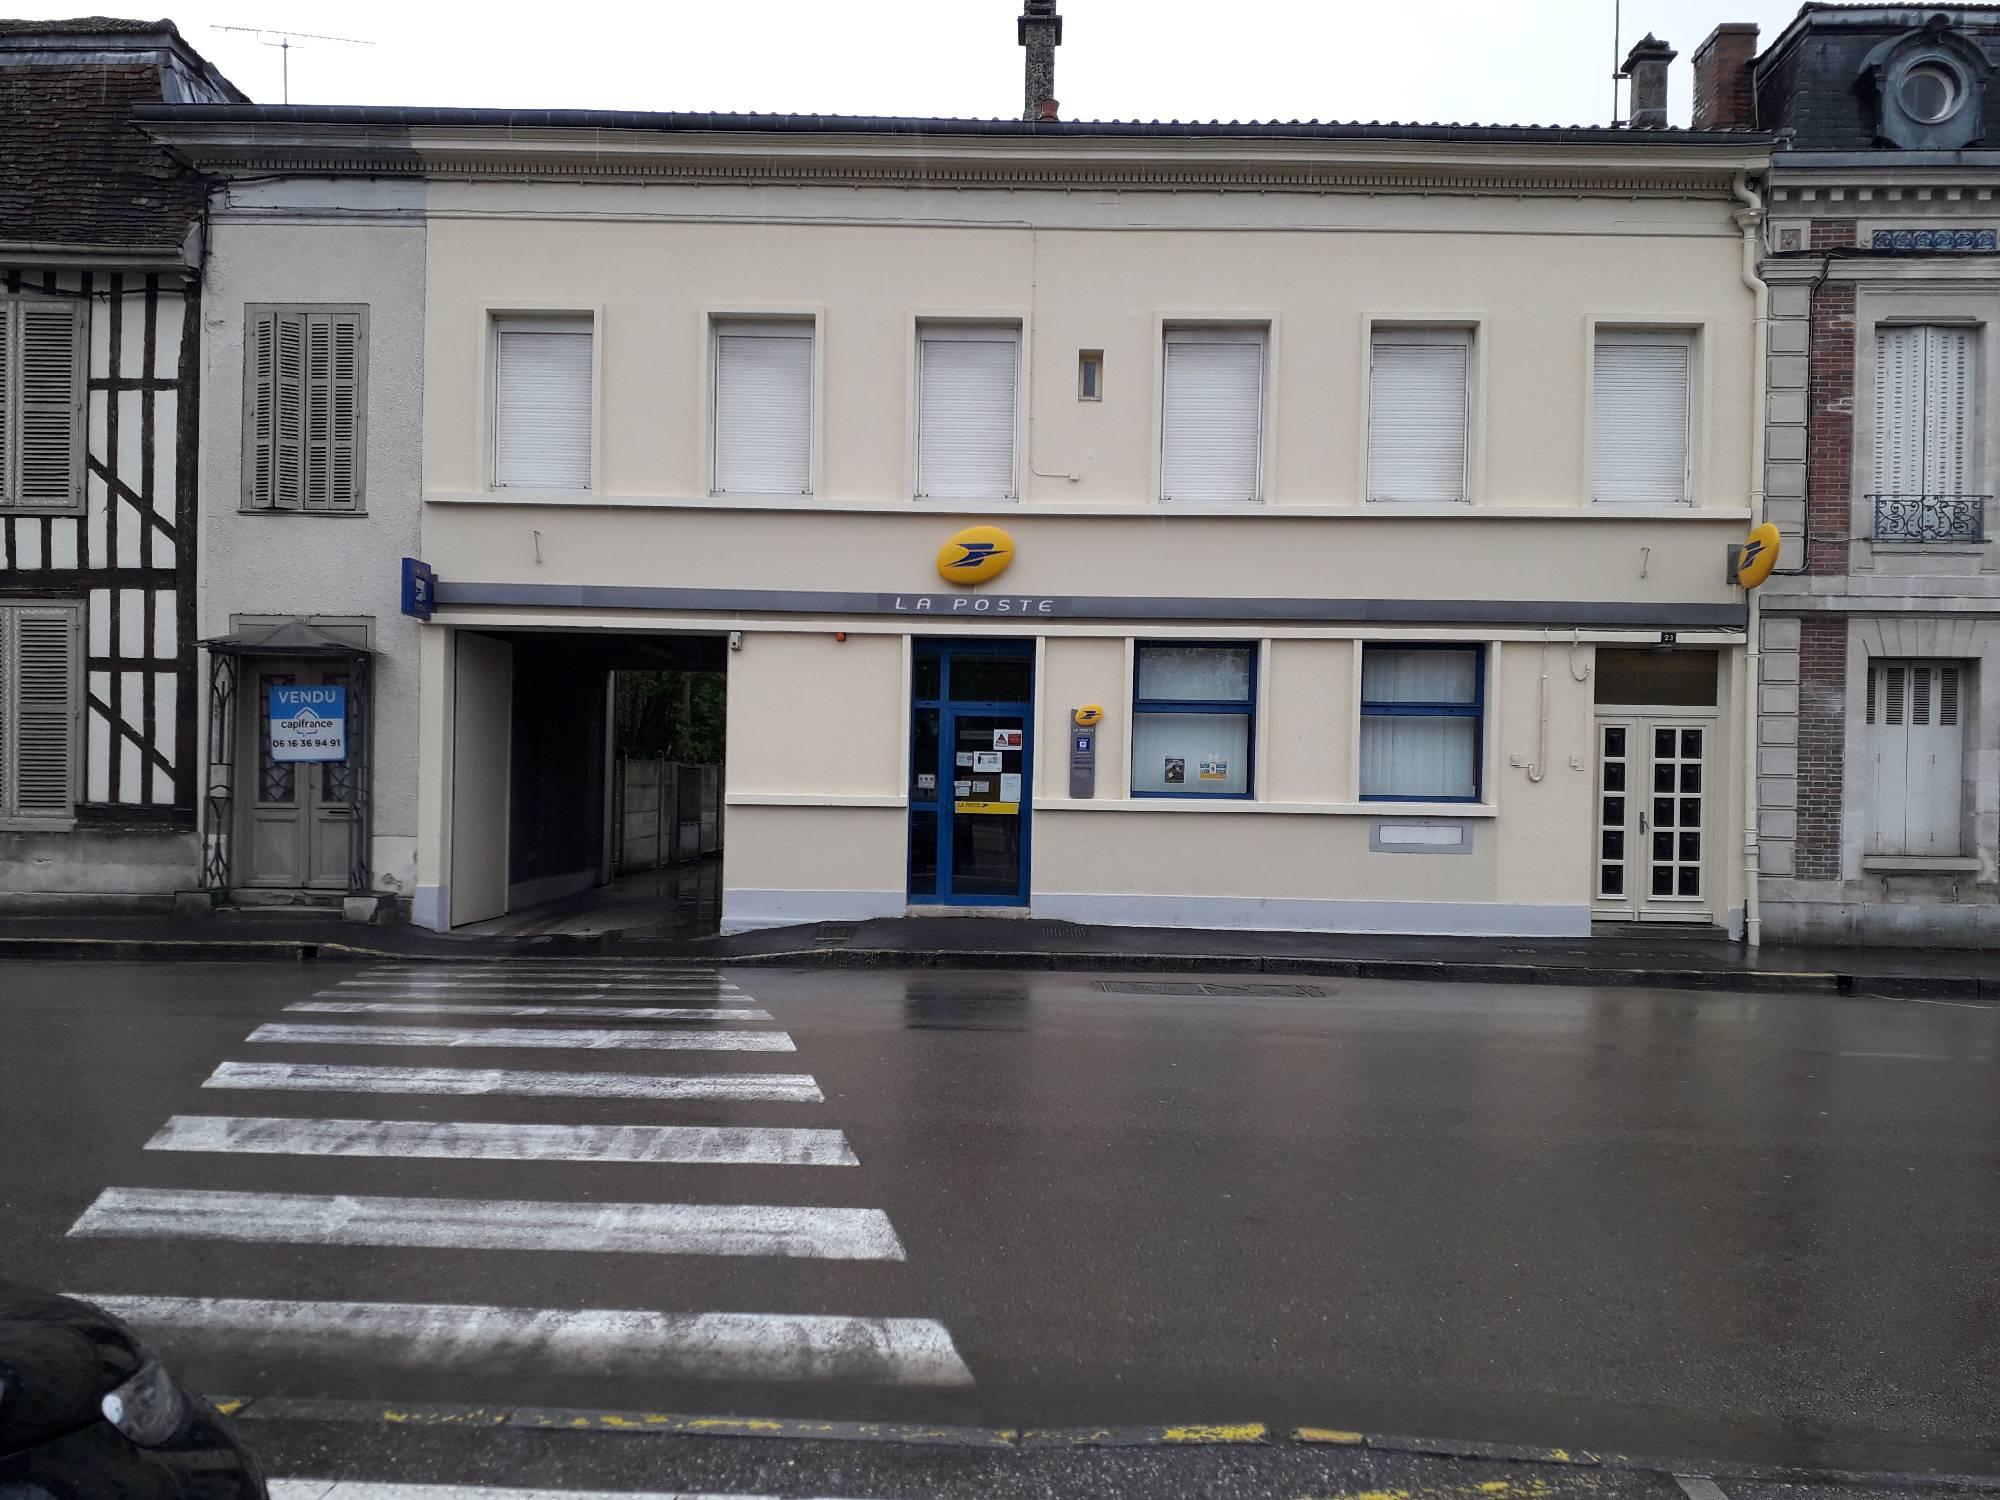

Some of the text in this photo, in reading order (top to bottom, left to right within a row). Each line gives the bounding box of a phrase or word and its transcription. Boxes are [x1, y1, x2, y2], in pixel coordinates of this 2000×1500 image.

[895, 597, 1054, 613] LA POSTE
[278, 690, 336, 704] VENDU
[280, 719, 333, 731] capifrance
[272, 738, 341, 748] 06 16 36 94 91
